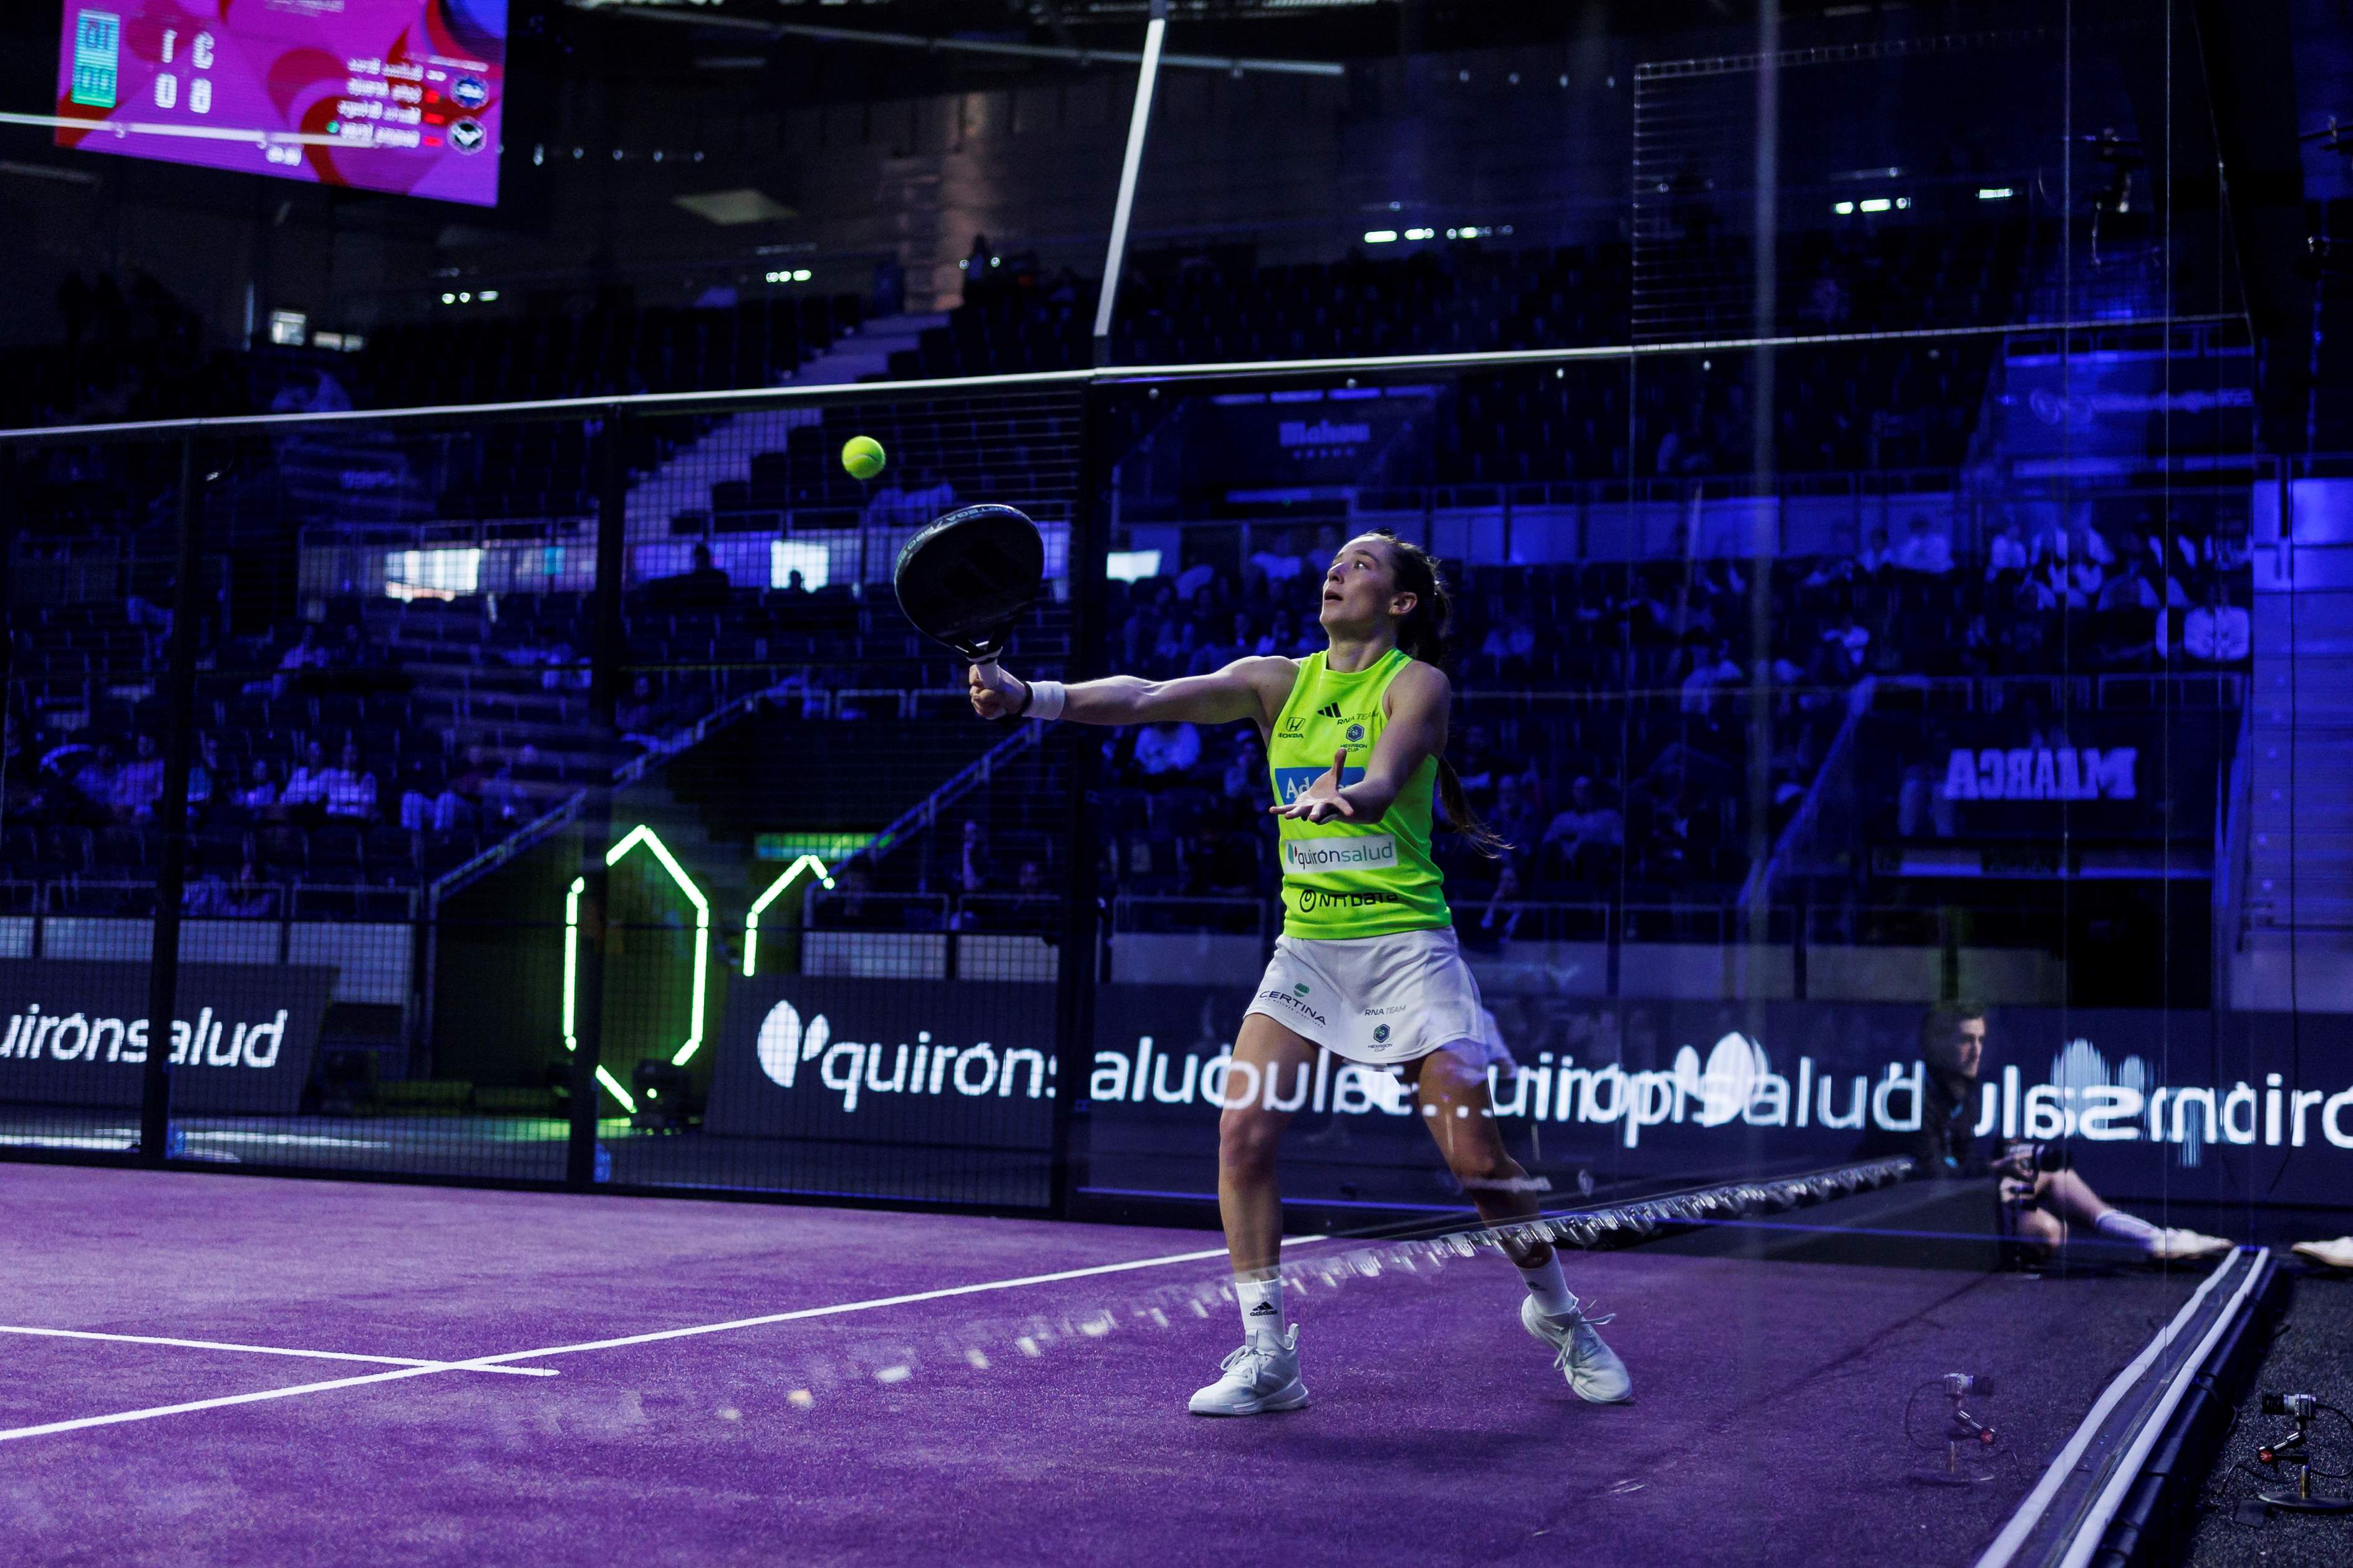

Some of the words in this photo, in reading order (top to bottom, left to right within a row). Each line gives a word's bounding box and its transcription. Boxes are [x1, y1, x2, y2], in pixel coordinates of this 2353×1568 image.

[1298, 842, 1393, 870] quirónsalud
[1260, 991, 1326, 1026] CERTINA
[1385, 1004, 1407, 1014] TEAM
